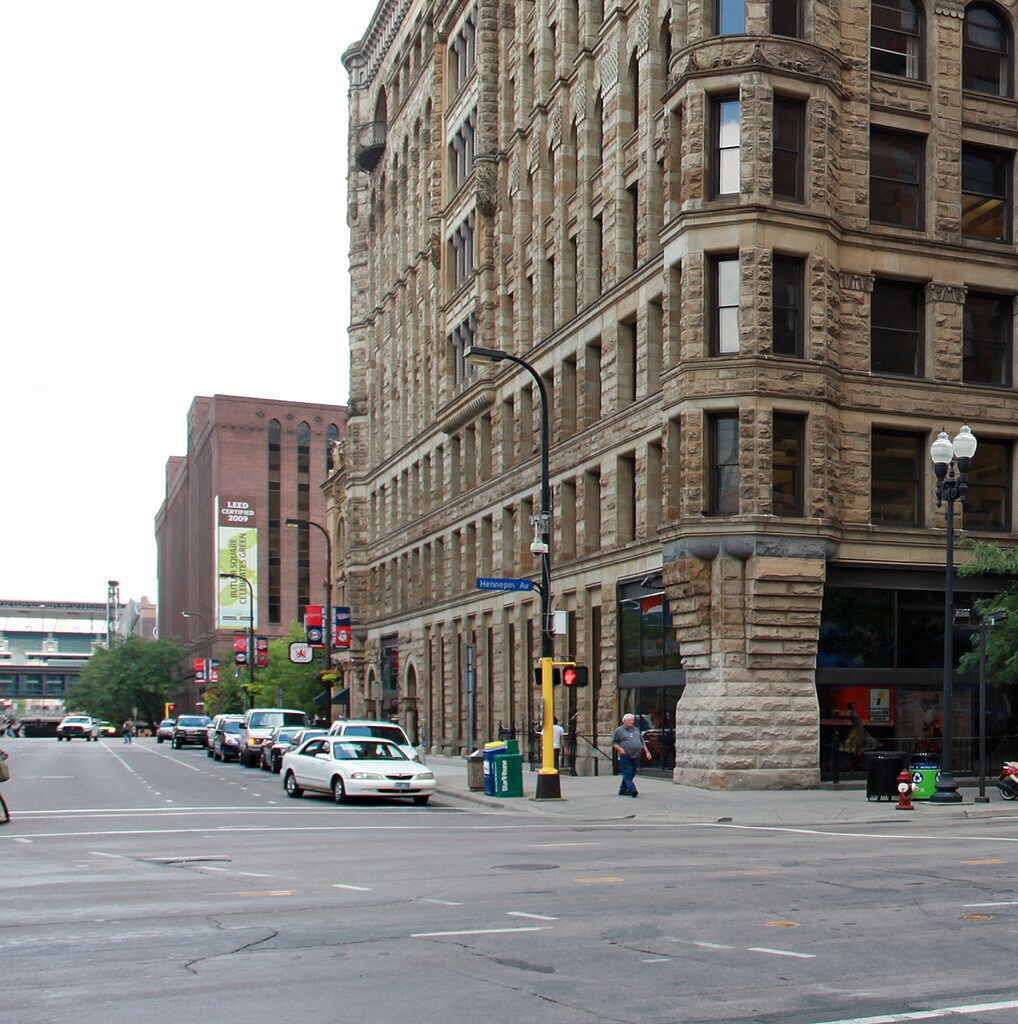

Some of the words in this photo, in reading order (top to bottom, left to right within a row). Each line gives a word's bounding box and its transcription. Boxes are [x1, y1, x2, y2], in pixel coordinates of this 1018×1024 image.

[221, 508, 255, 516] CERTIFIED
[227, 501, 249, 509] LEED
[230, 538, 238, 569] SQUARE
[239, 533, 247, 558] GREEN
[230, 569, 238, 598] BUTLR
[479, 580, 515, 590] Hennepin
